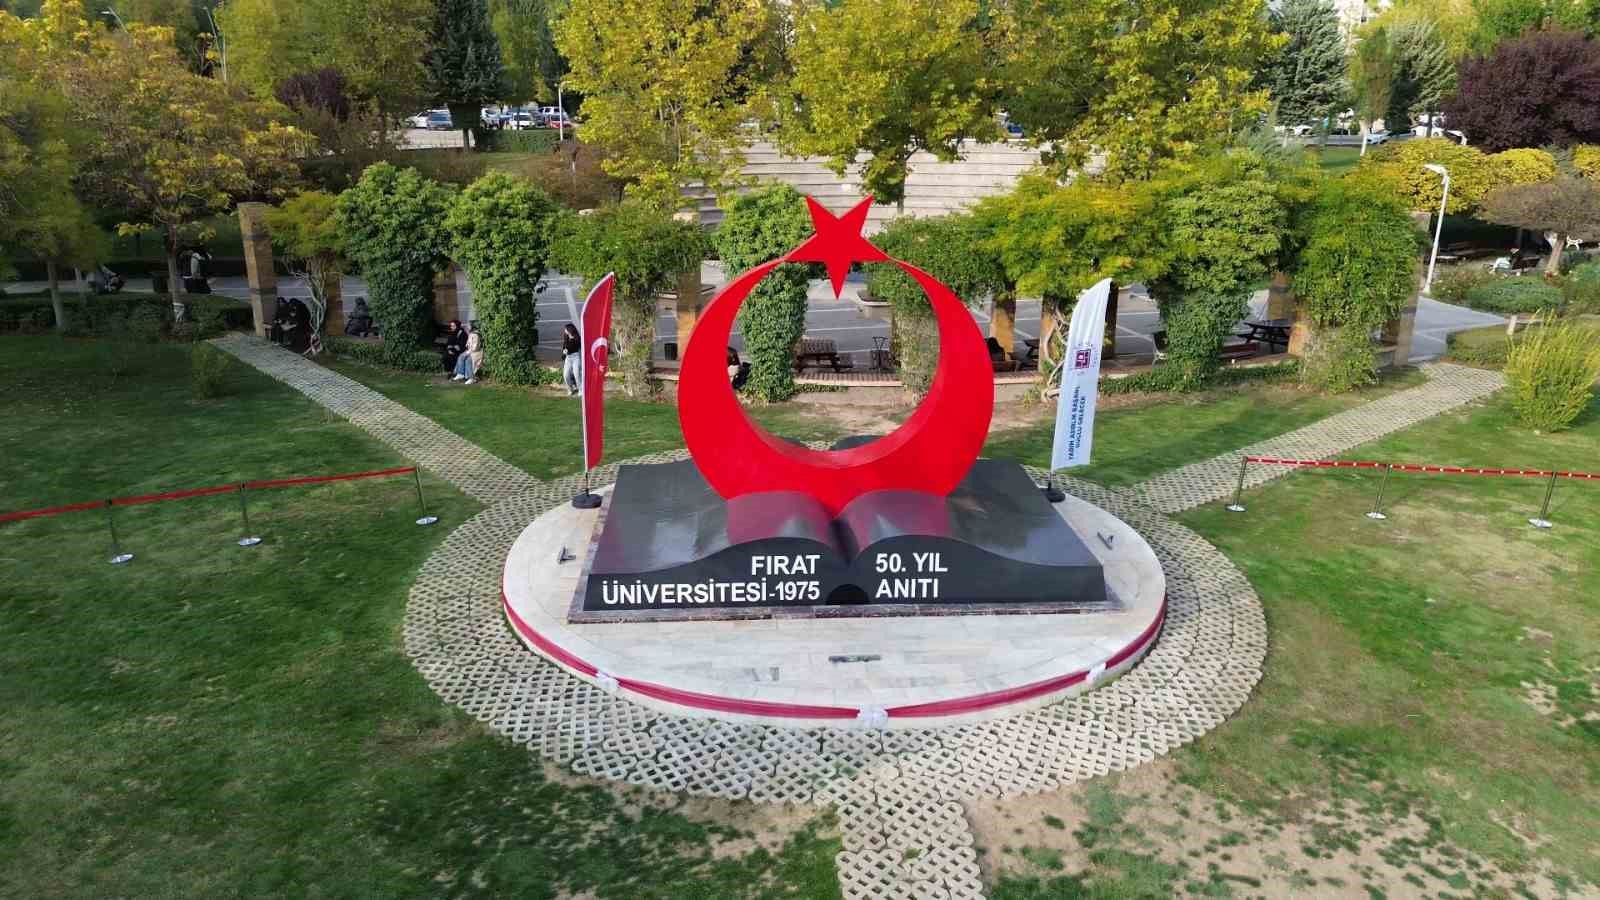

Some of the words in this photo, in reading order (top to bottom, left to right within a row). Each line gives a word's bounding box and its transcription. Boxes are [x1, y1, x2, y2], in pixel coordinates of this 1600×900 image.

[751, 554, 820, 576] FIRAT
[875, 552, 907, 573] 50.
[912, 552, 949, 573] YIL
[875, 578, 939, 599] ANITI
